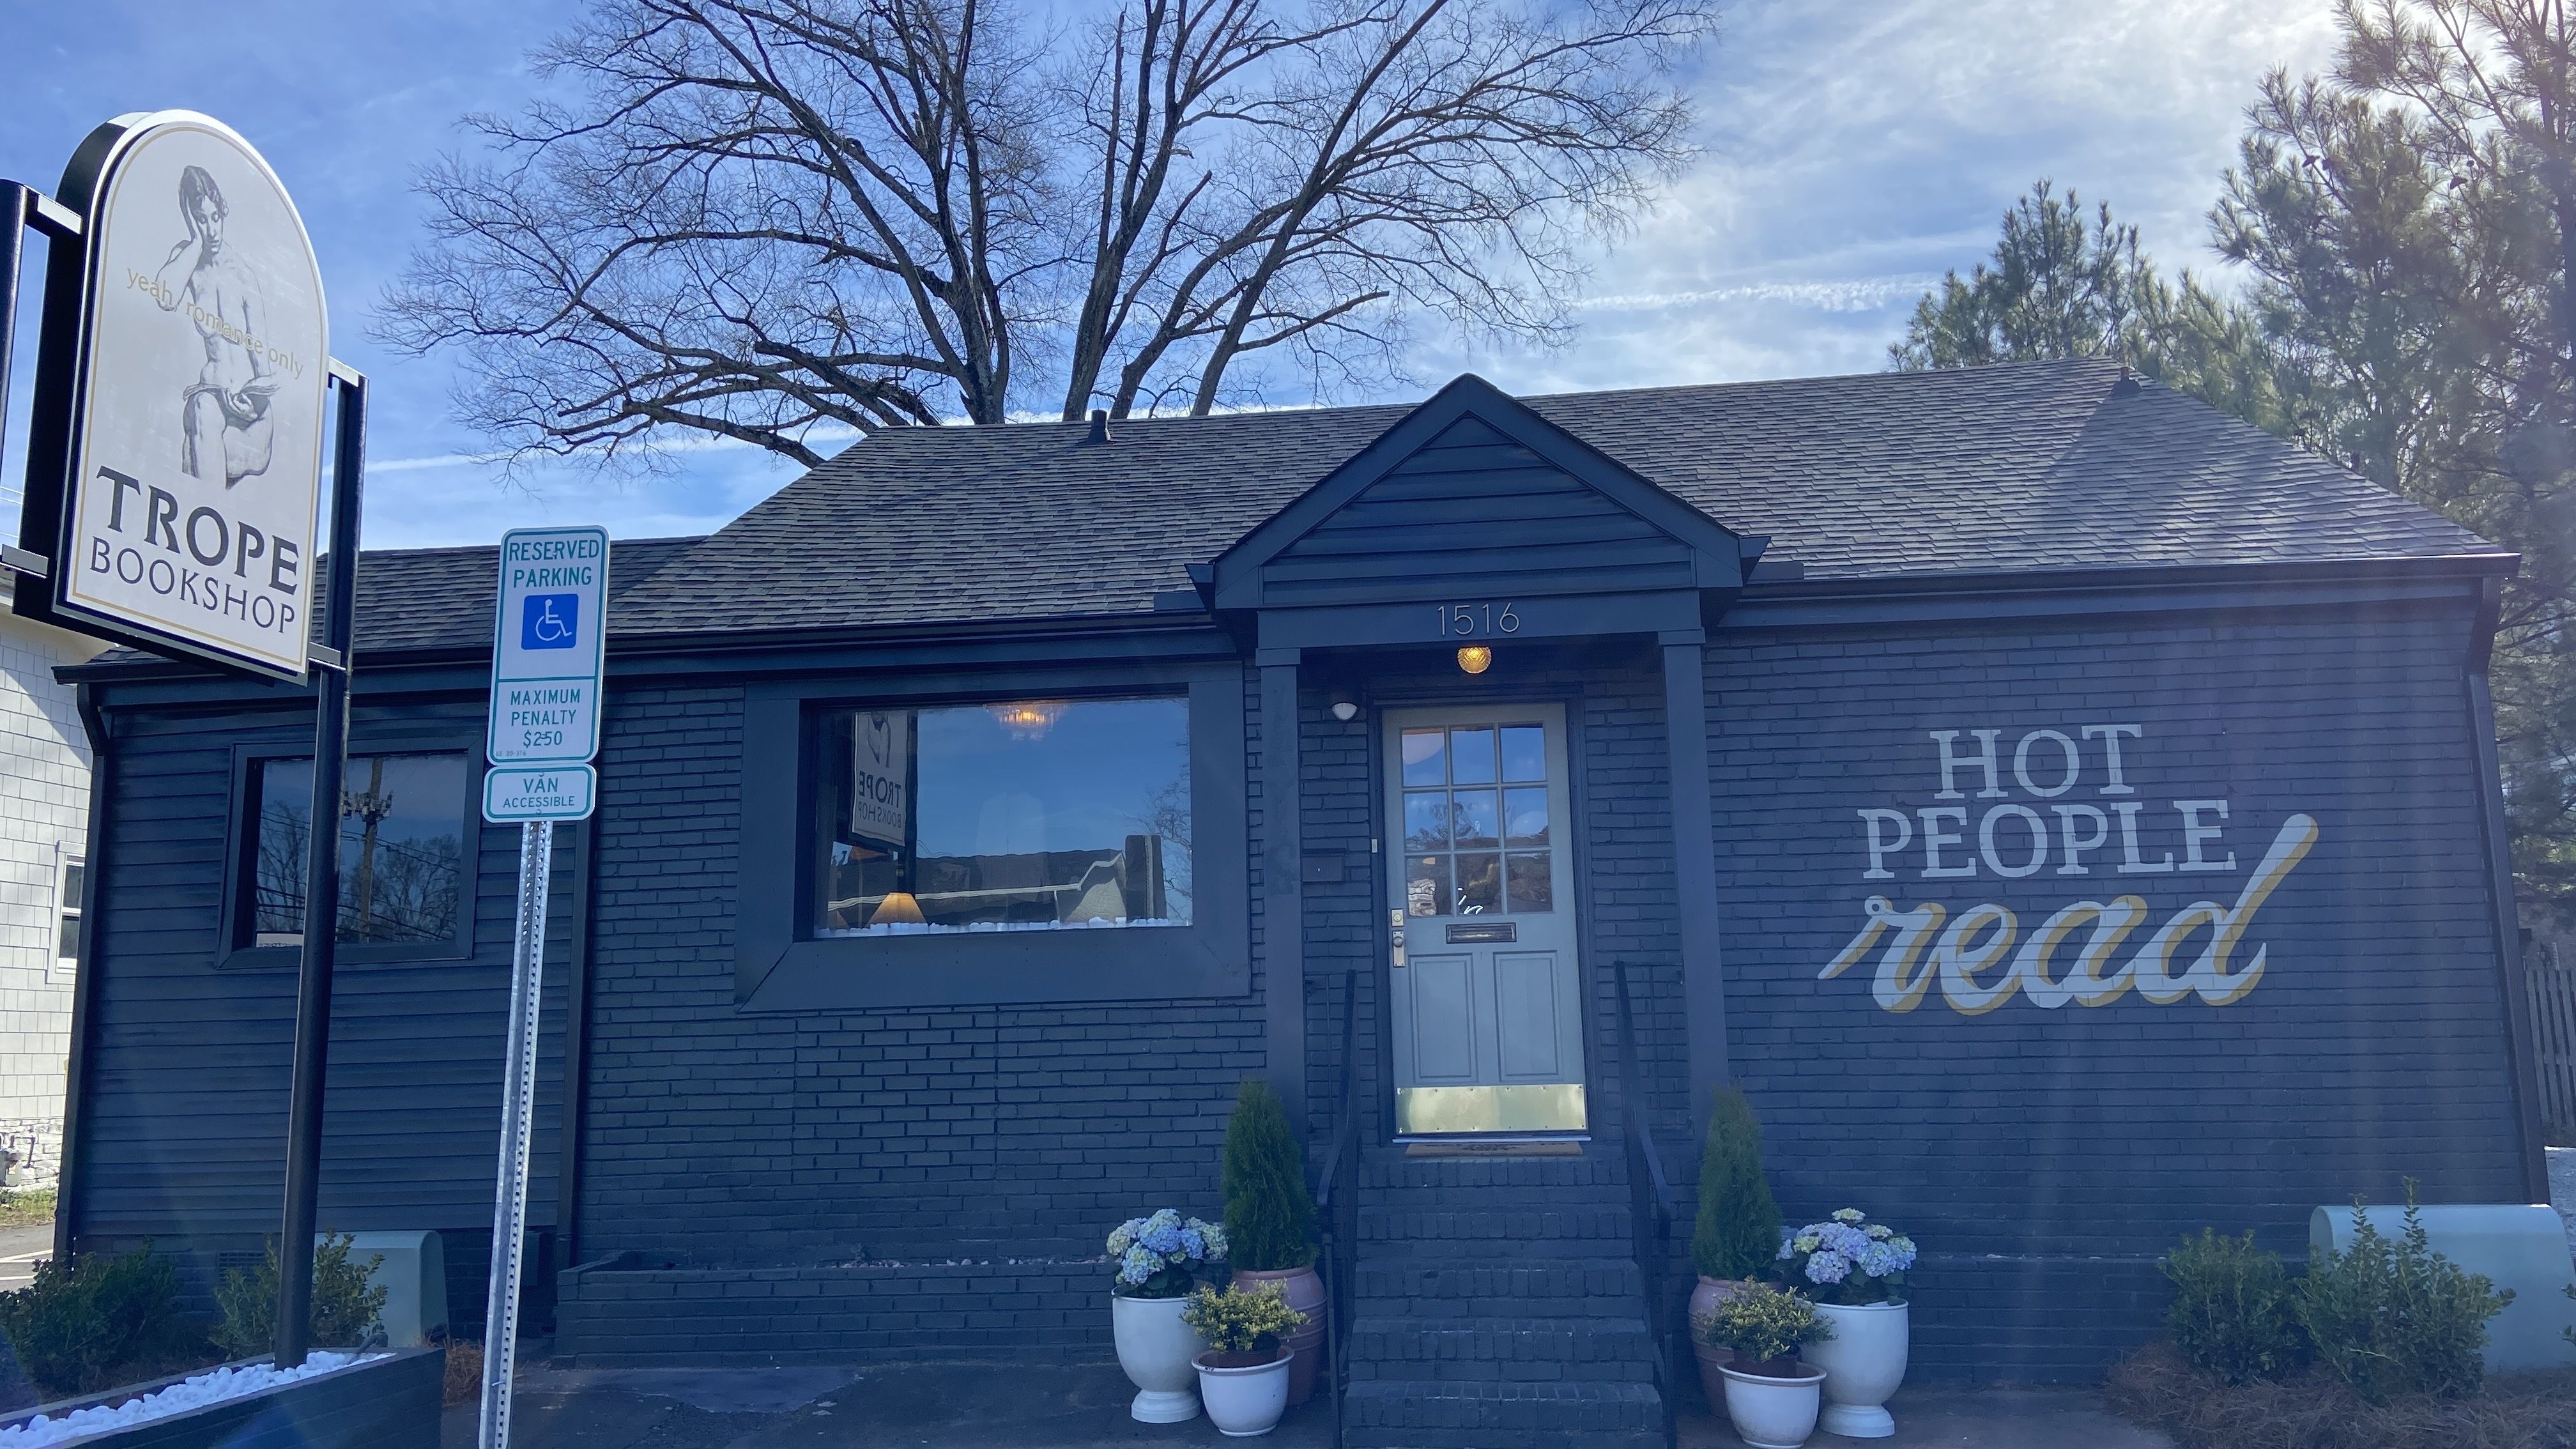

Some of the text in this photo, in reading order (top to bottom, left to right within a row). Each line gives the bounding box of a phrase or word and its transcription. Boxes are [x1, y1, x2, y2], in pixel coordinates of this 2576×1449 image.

[185, 301, 264, 354] romance
[268, 347, 303, 380] only
[96, 464, 299, 596] TROPE
[509, 539, 599, 562] RESERVED
[89, 535, 295, 634] BOOKSHOP
[513, 566, 592, 588] PARKING
[1437, 602, 1521, 636] 1516
[510, 688, 581, 706] MAXIMUM
[511, 709, 577, 726] PENALTY
[523, 730, 563, 749] $250
[1929, 723, 2143, 800] HOT
[523, 778, 558, 793] VAN
[502, 795, 576, 809] ACCESSIBLE
[1857, 799, 2237, 879] PEOPLE
[1817, 813, 2319, 1016] read
